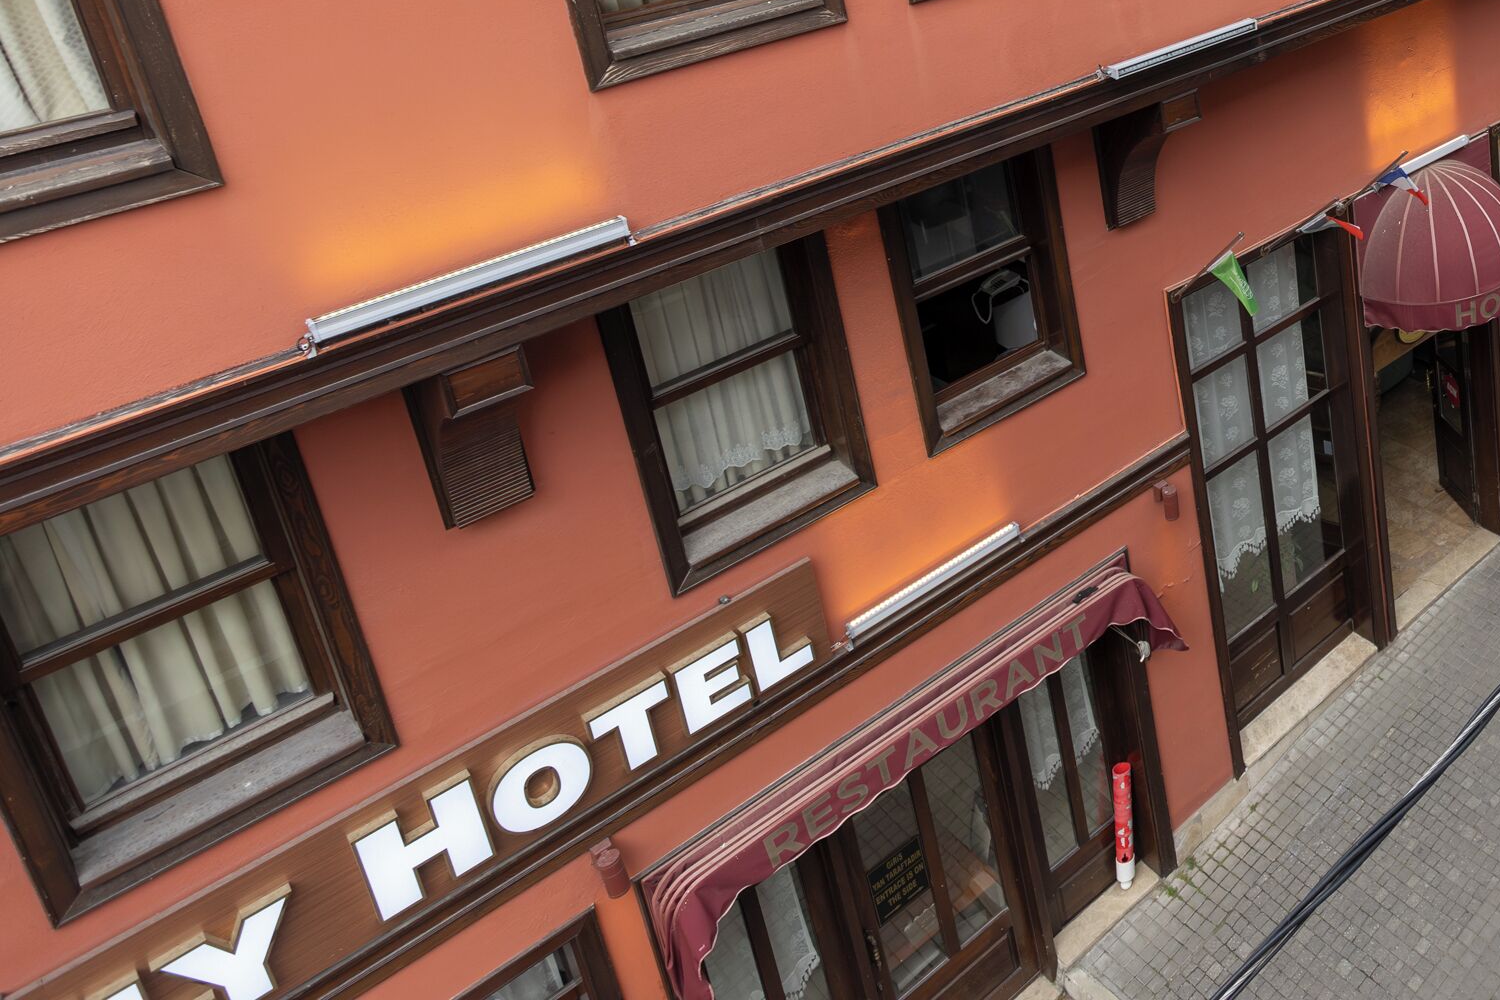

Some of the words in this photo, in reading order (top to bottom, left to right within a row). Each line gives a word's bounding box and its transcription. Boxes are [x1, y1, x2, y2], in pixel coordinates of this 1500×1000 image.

[763, 614, 1087, 868] RESTAURANT
[350, 612, 816, 923] HOTEL
[872, 877, 886, 891] YAN
[875, 879, 905, 905] ENTRACE
[906, 871, 914, 882] IS
[914, 862, 924, 874] ON
[888, 892, 902, 906] THE
[902, 880, 918, 896] SIDE
